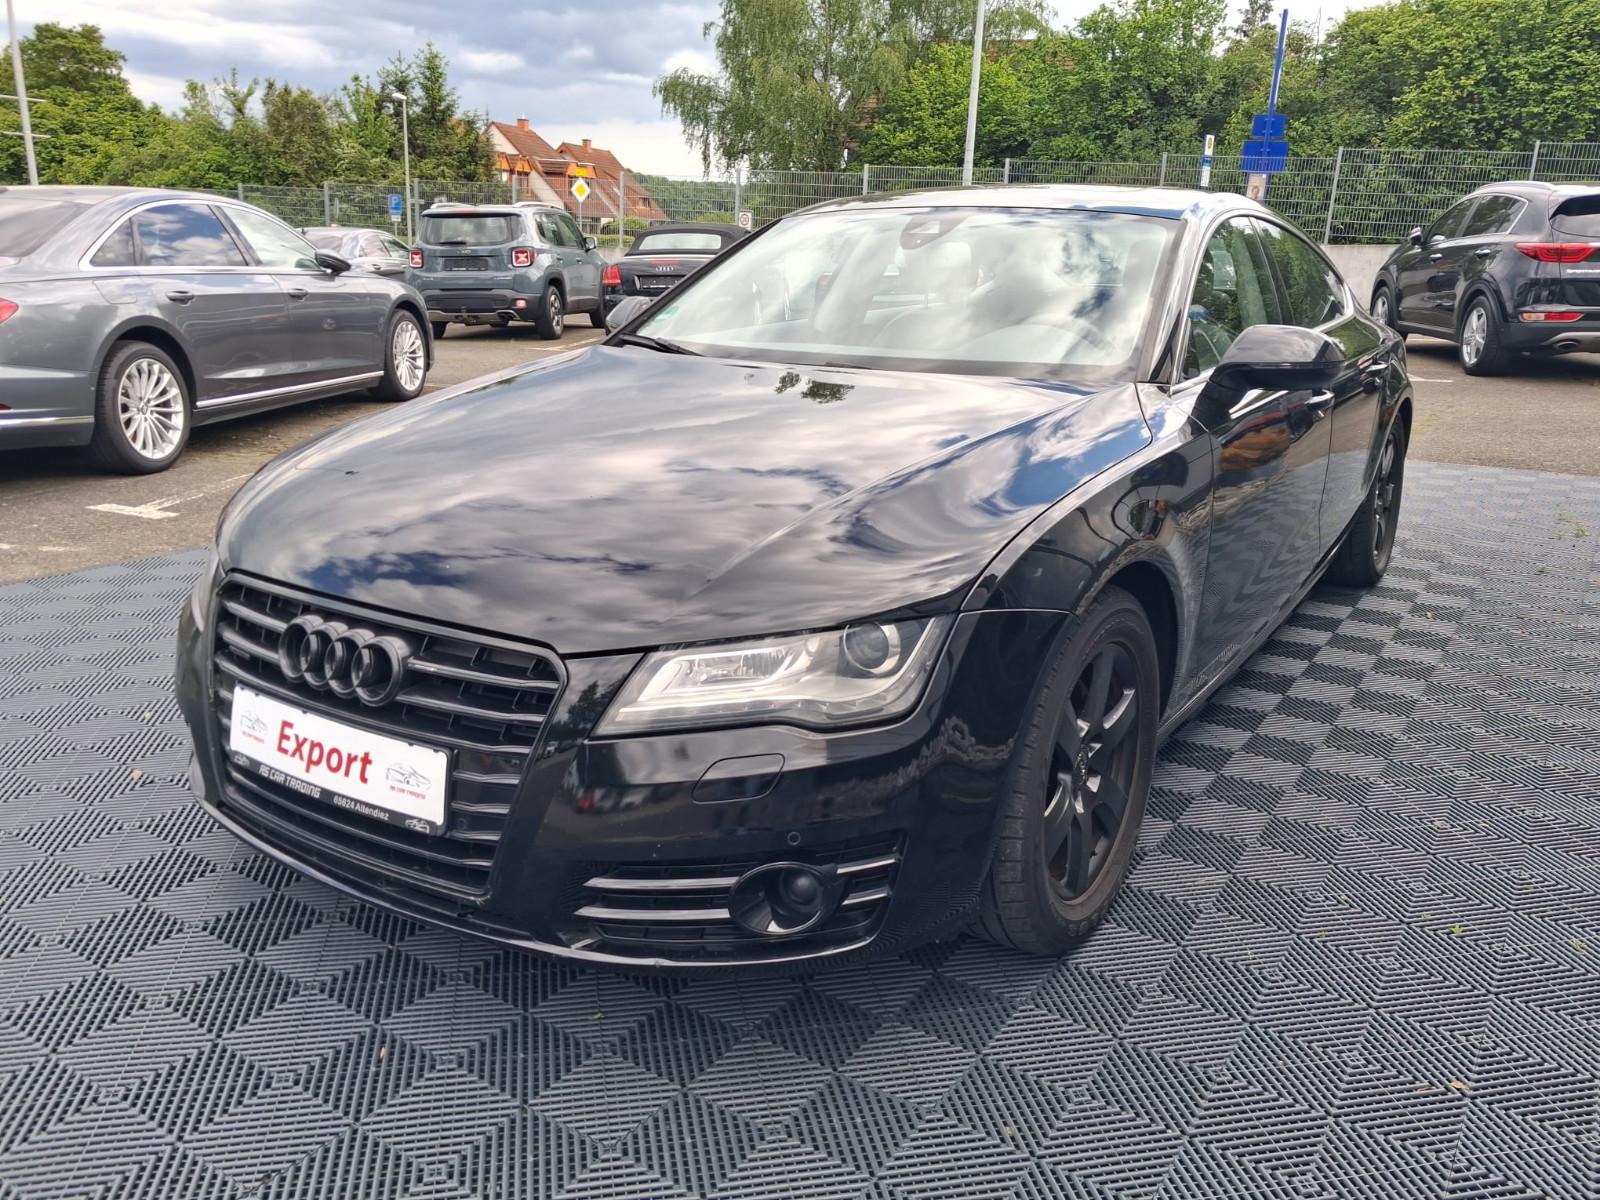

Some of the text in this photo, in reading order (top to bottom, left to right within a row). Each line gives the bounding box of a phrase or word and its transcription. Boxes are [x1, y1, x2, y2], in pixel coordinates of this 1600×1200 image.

[276, 720, 373, 784] Export
[270, 768, 285, 784] CAR
[286, 776, 322, 798] TRADING
[355, 803, 390, 821] Altendiez
